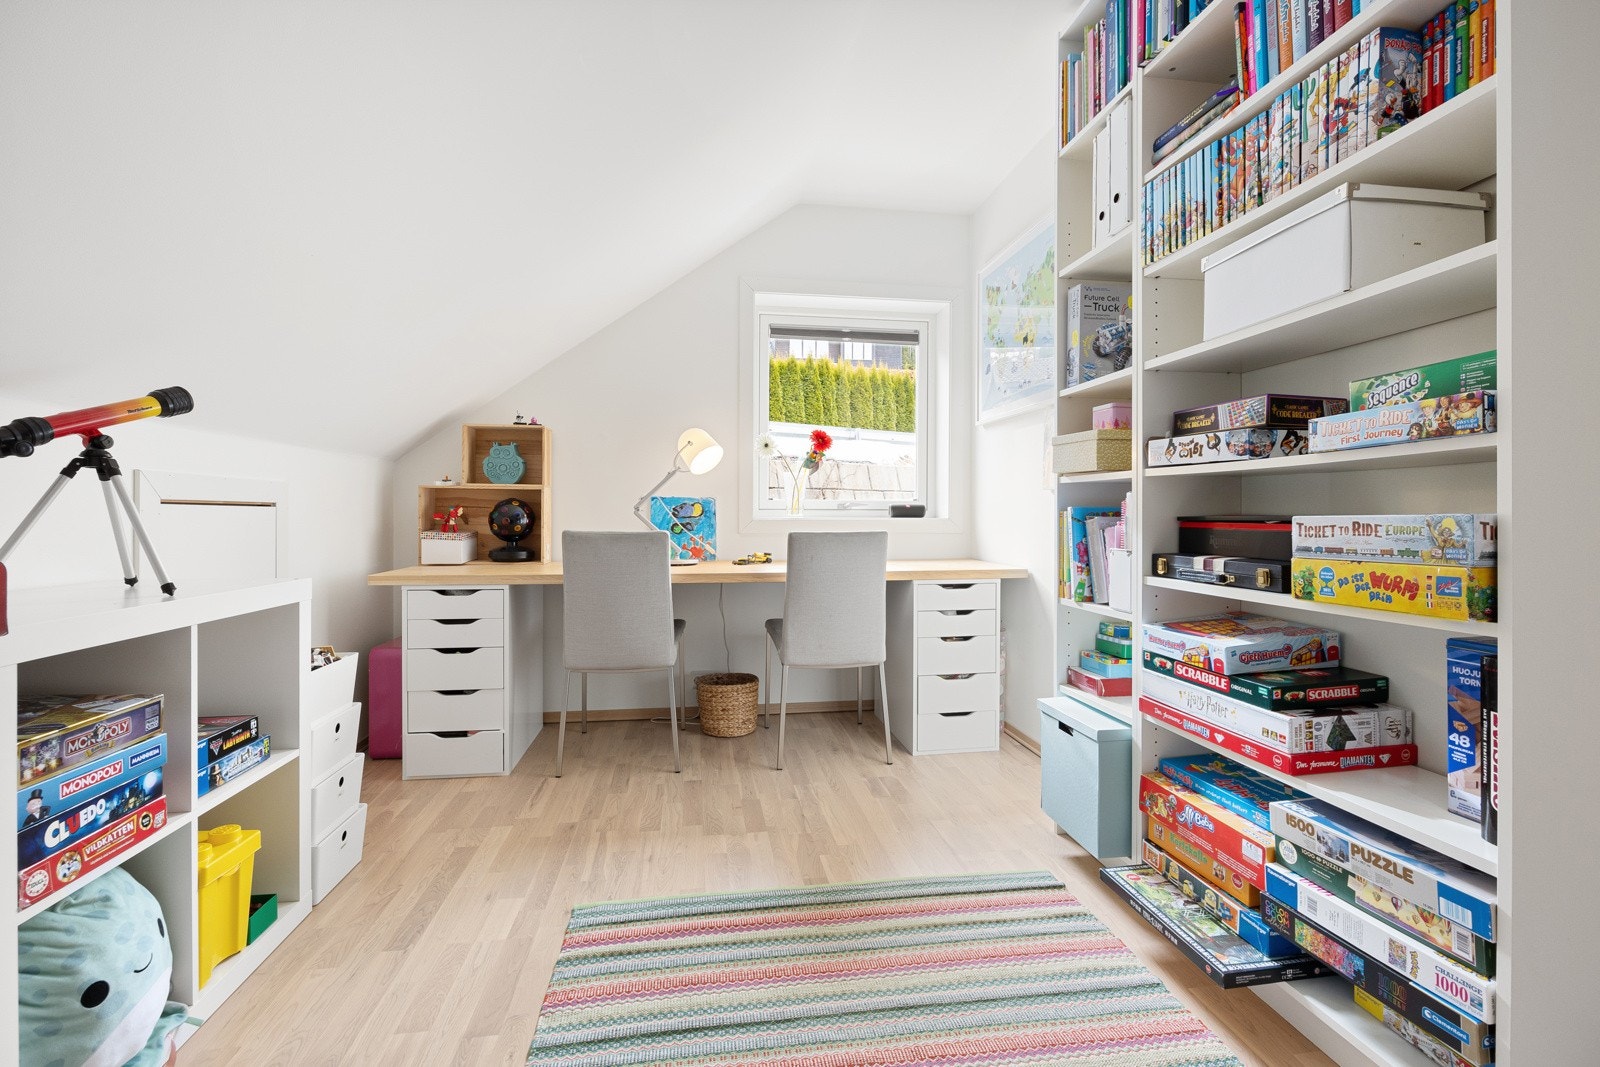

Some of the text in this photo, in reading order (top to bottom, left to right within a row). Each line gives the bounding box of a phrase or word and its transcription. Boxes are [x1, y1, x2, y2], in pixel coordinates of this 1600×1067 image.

[1084, 294, 1105, 302] Future
[1367, 372, 1419, 410] Sequence
[1276, 410, 1292, 418] CODE
[1320, 409, 1413, 437] TICKET TO RIDE
[1341, 428, 1404, 445] First Journey
[1296, 521, 1425, 539] TICKET TO RIDE EUROPE
[1369, 571, 1419, 601] WURM
[1240, 650, 1262, 664] Gjett
[1262, 644, 1293, 661] Hvem?
[1176, 664, 1253, 695] SCRABBLE ORIGINAL
[1186, 691, 1229, 718] Harry Potter
[1309, 687, 1358, 700] SCRABBLE
[1449, 732, 1471, 748] 48
[131, 748, 160, 765] MANNHEIM
[1296, 761, 1308, 769] Den
[1340, 754, 1376, 768] DIAMANTEN
[62, 763, 122, 797] MONOPOLY
[44, 798, 106, 848] CLUEDO
[1286, 812, 1315, 836] 1500
[85, 821, 134, 854] VILDKATTEN
[1301, 848, 1343, 873] 1000 PUZZLE
[1350, 843, 1414, 885] PUZZLE
[1265, 900, 1289, 918] COLOR
[1266, 906, 1290, 928] BOOM
[1435, 965, 1482, 995] CHALLENGE
[1435, 972, 1468, 1002] 1000
[1432, 1015, 1466, 1041] Clementoni
